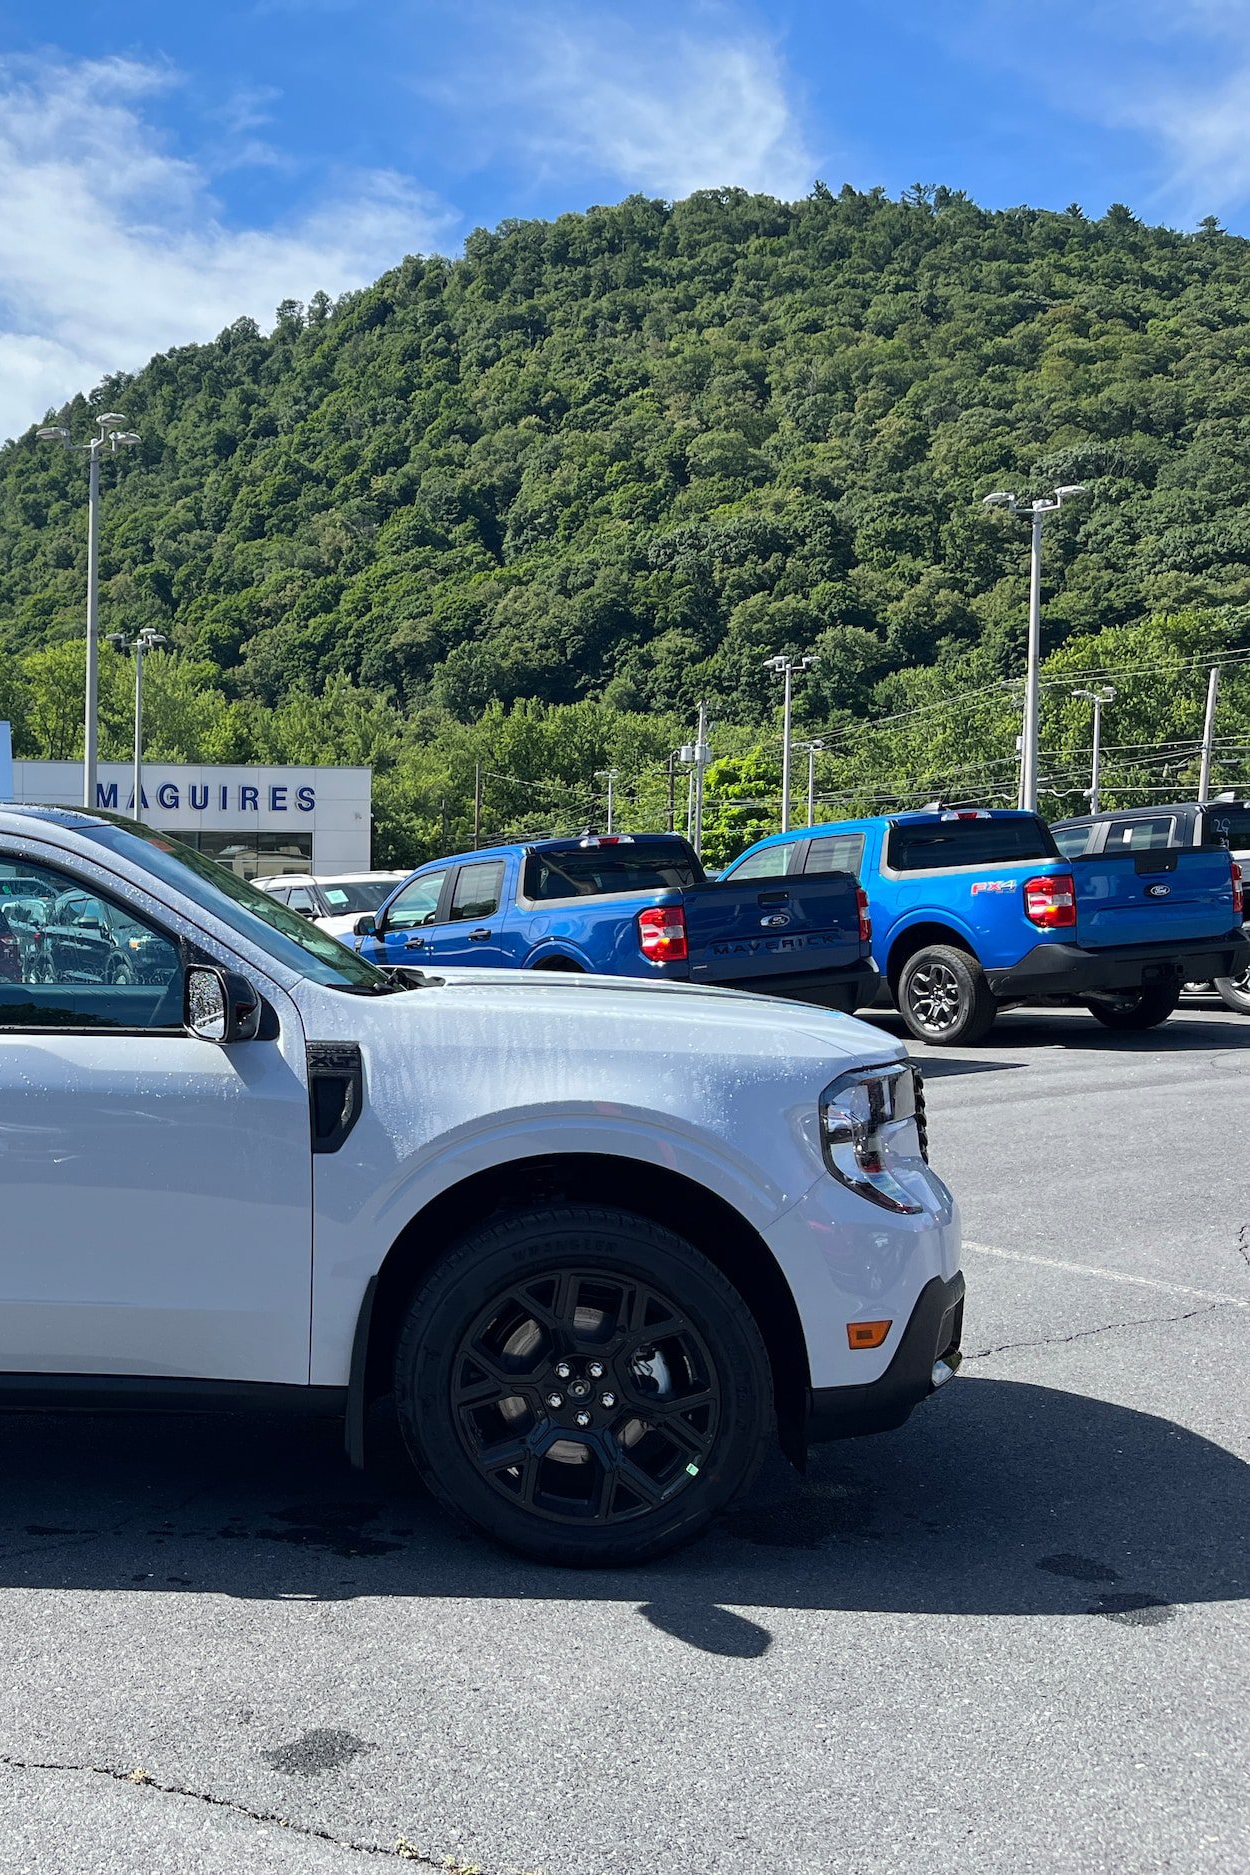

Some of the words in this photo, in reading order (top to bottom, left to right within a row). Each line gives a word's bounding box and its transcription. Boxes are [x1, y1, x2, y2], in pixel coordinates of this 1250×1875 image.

[95, 782, 317, 812] MAGUIRES
[971, 879, 1017, 897] FX4
[712, 935, 836, 956] MAVERICK
